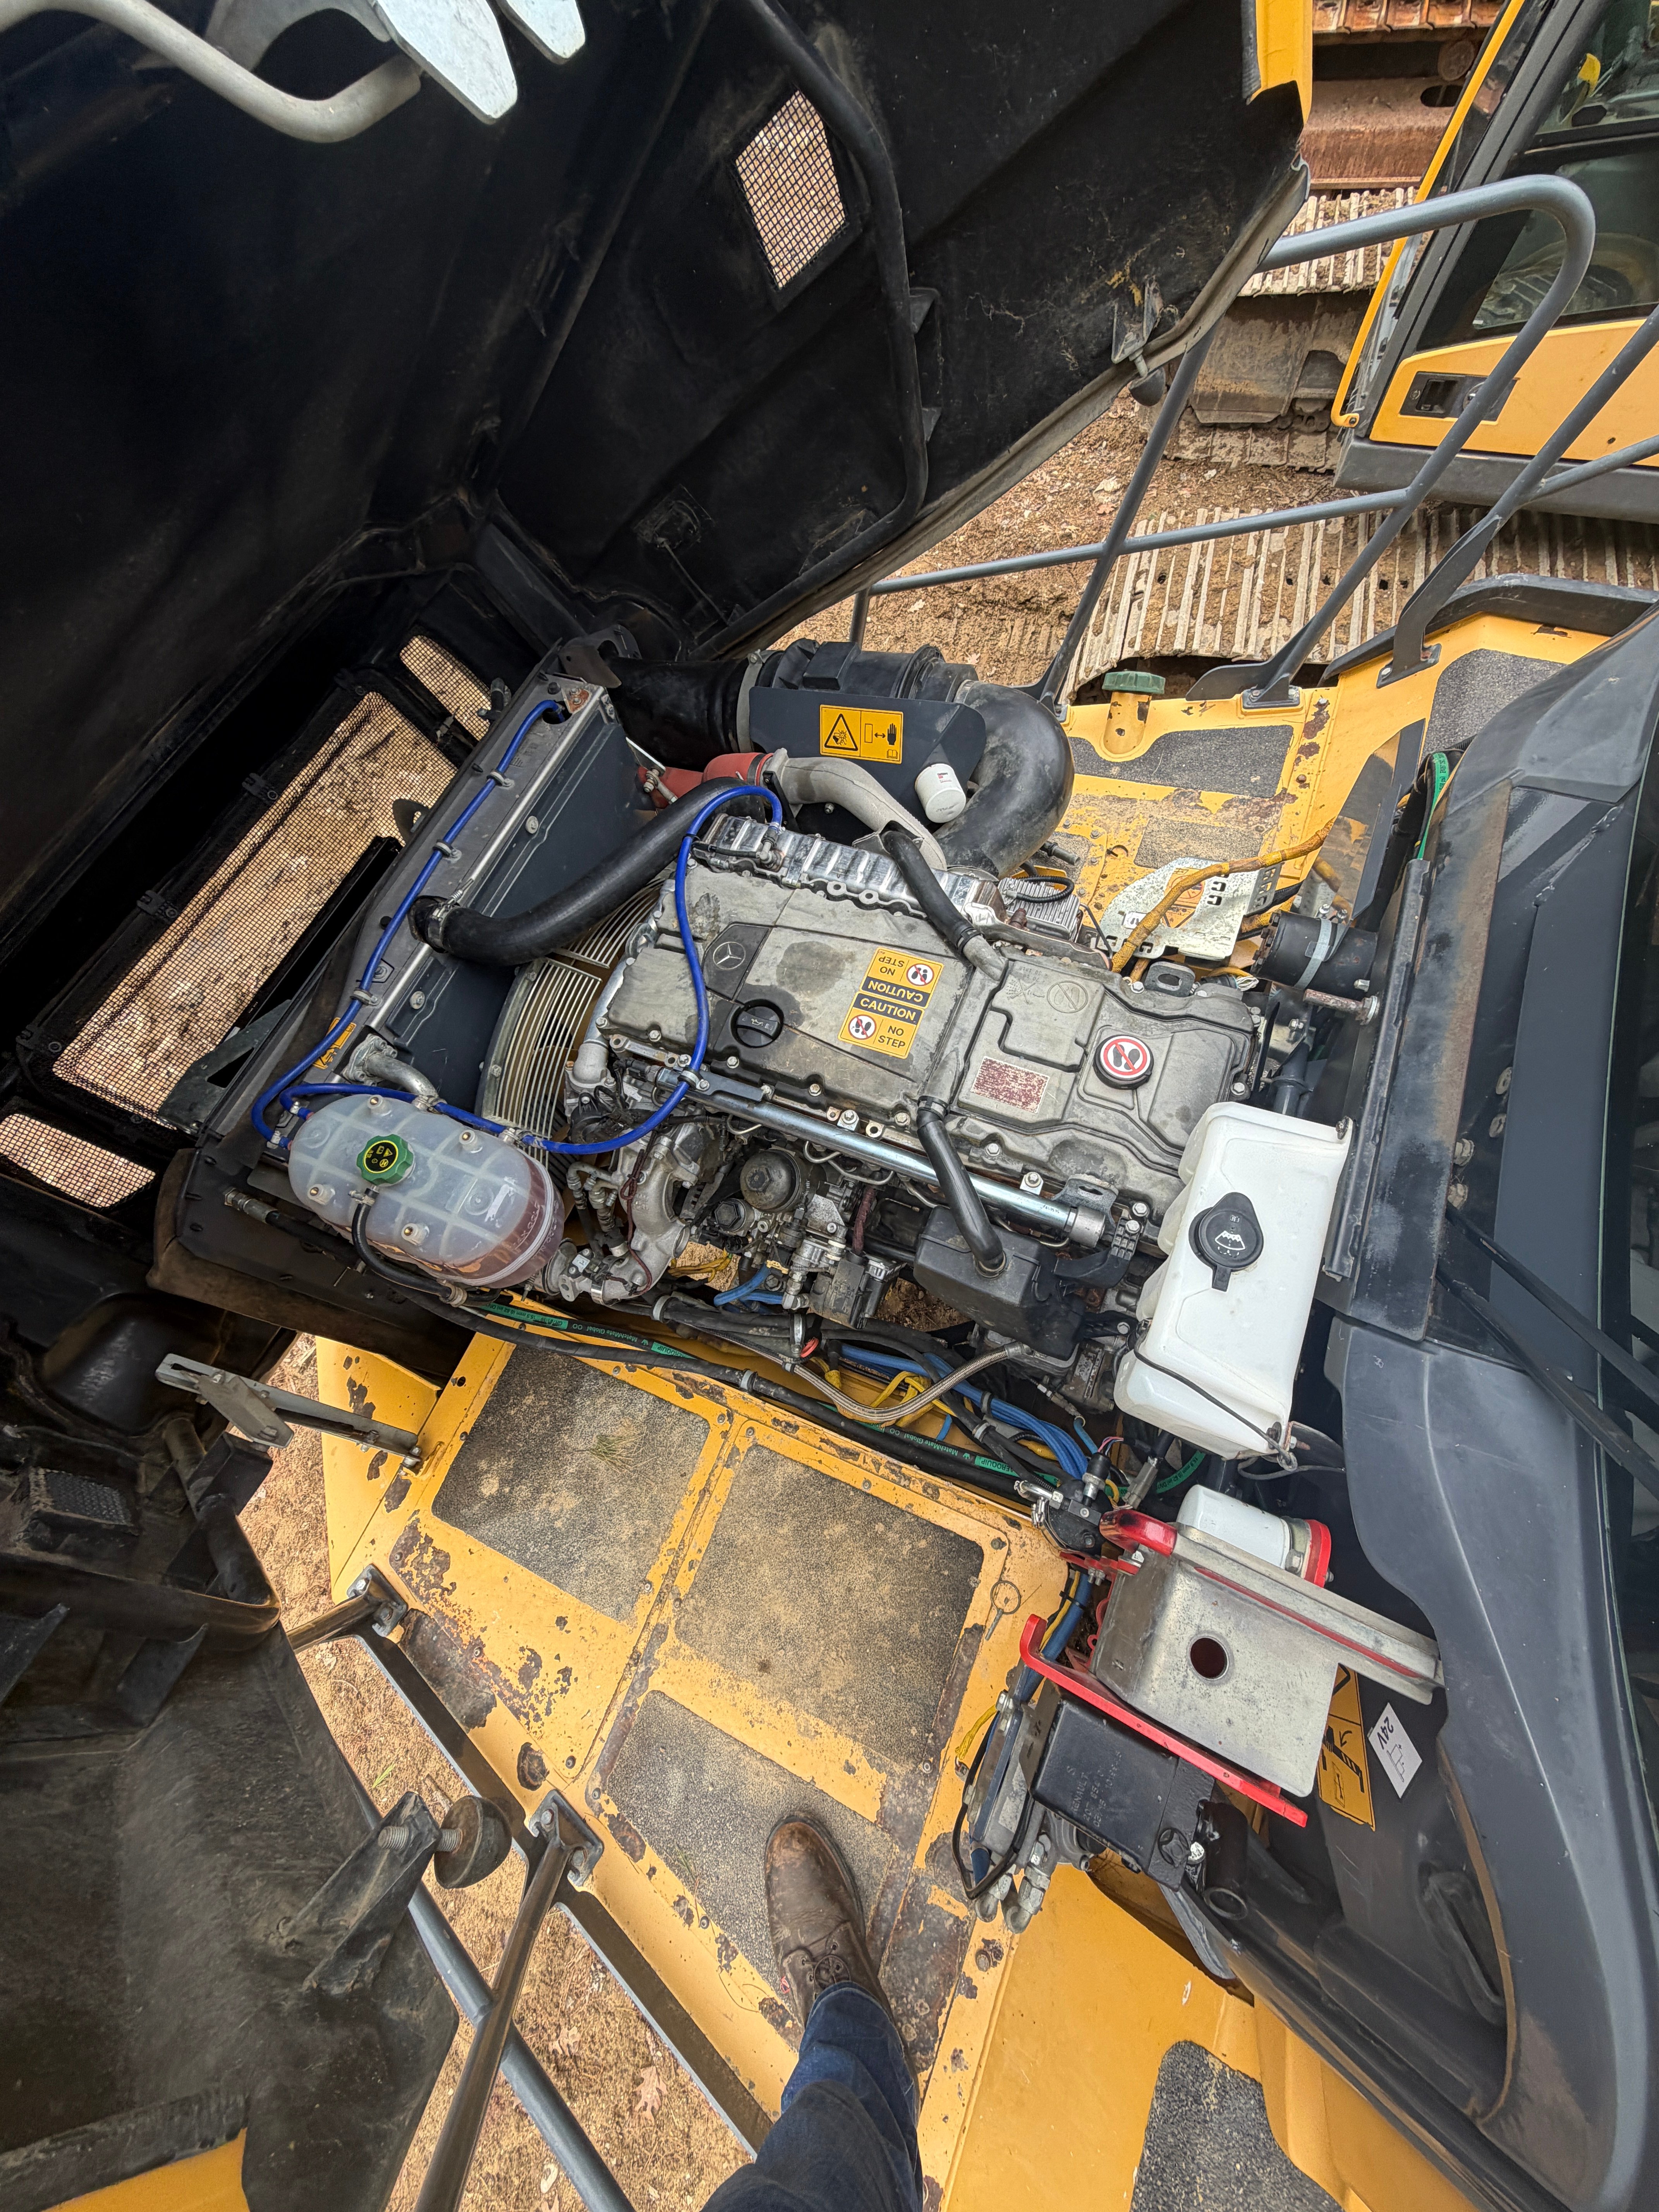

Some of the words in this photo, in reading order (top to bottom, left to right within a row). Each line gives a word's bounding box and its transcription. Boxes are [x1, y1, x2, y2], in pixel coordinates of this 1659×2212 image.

[878, 956, 905, 967] STEP
[879, 966, 896, 976] NO
[868, 980, 923, 1002] CAUTION
[860, 998, 916, 1021] CAUTION
[888, 1025, 904, 1036] NO
[878, 1035, 906, 1048] STEP
[586, 1326, 605, 1334] Global
[606, 1330, 638, 1342] MatchMate
[904, 1433, 924, 1444] Global
[924, 1440, 958, 1456] MatchMate
[1377, 1716, 1394, 1750] 24V
